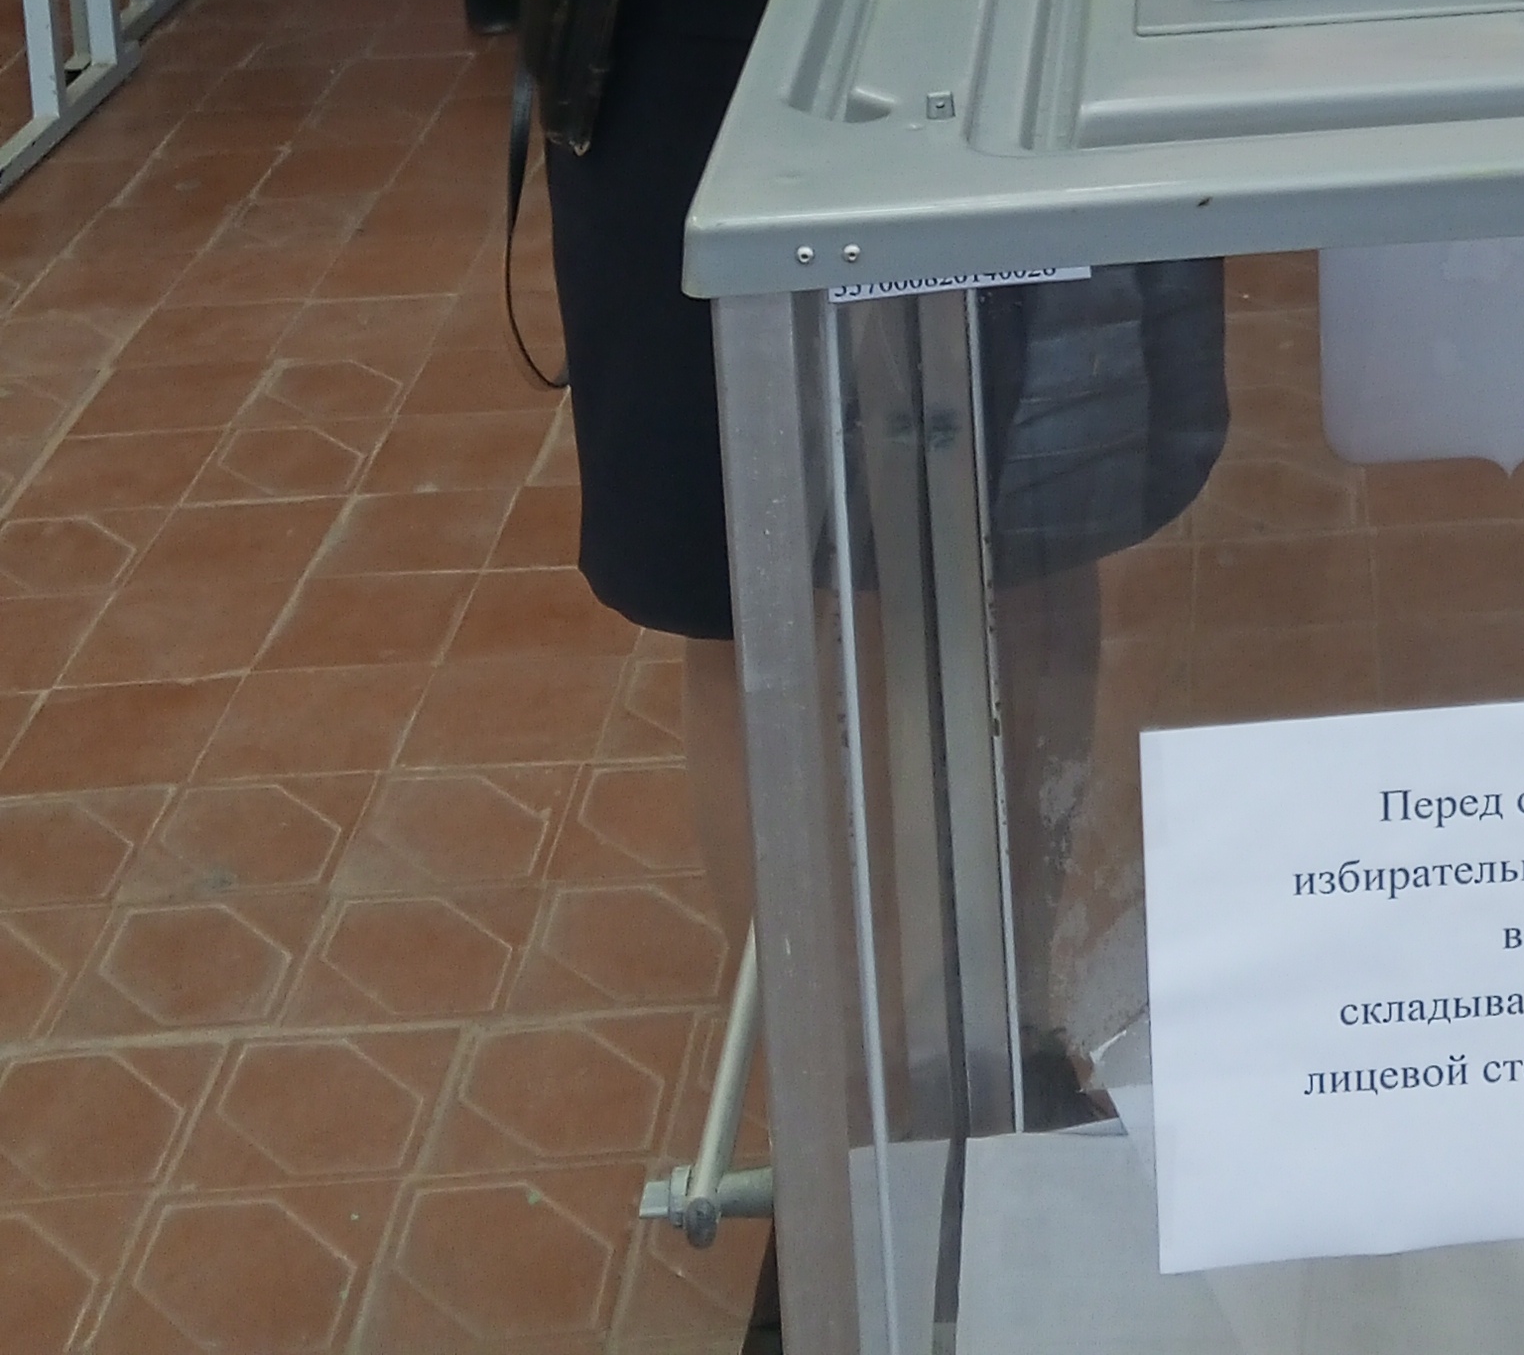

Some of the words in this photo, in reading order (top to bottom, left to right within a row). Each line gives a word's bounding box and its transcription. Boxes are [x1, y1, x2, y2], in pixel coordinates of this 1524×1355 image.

[1379, 789, 1503, 828] Перед
[1502, 926, 1523, 950] в
[1304, 1055, 1469, 1096] лицевой
